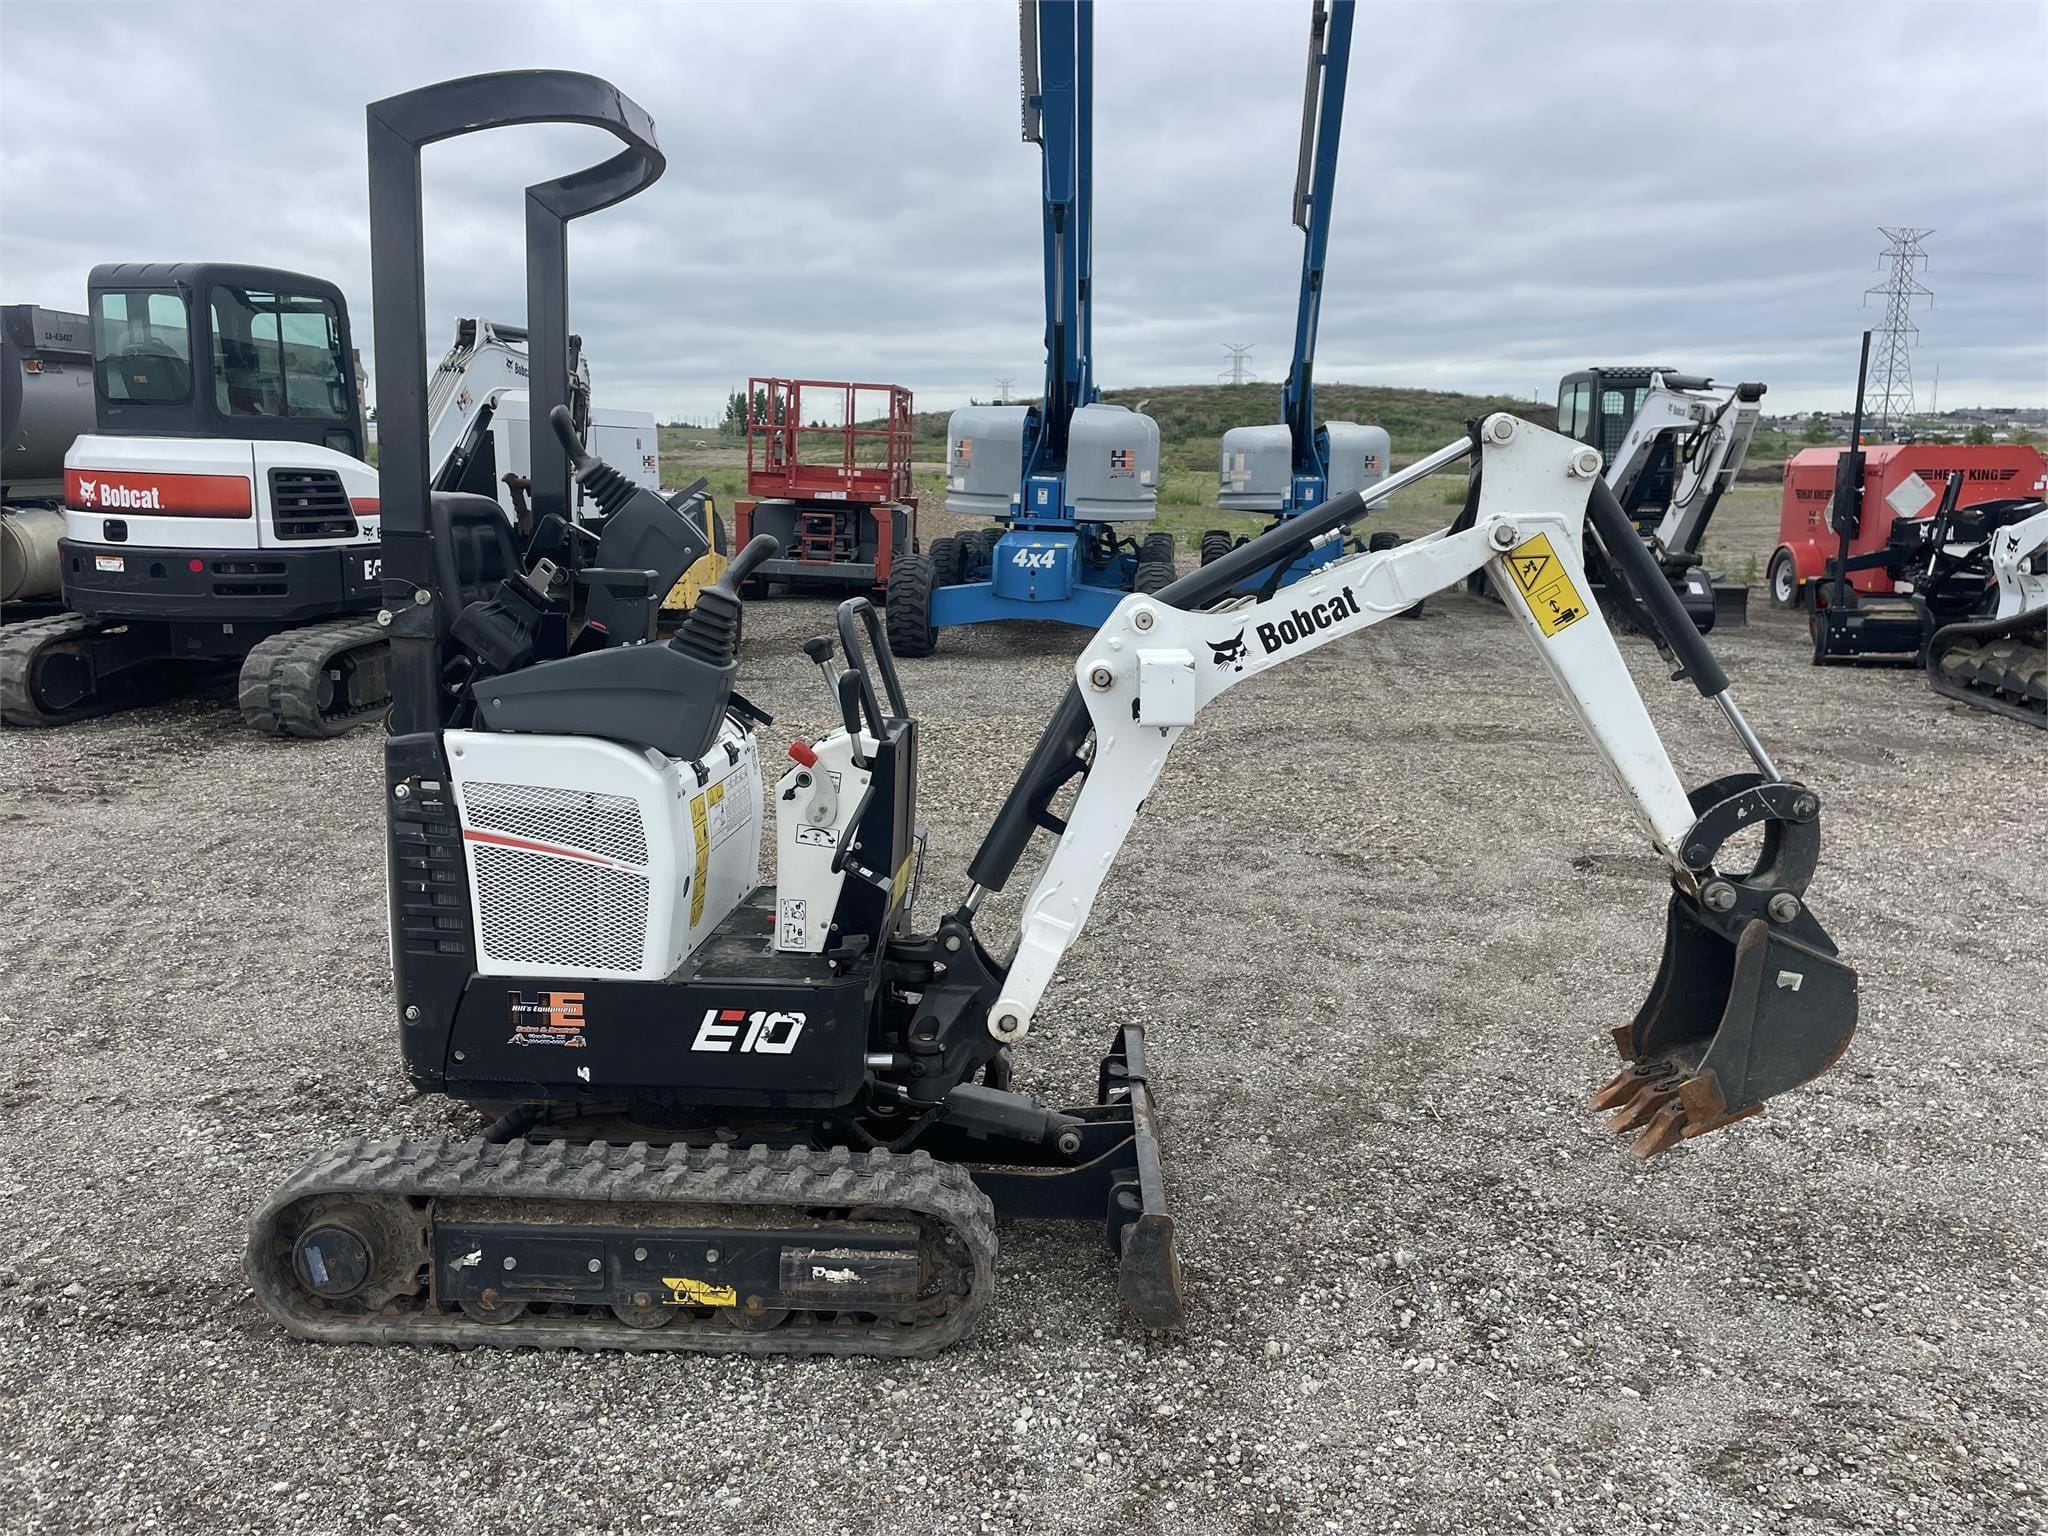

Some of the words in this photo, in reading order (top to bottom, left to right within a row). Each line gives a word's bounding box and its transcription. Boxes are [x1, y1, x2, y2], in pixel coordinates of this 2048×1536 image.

[1111, 449, 1136, 471] HE
[1933, 469, 1966, 481] HET
[1968, 469, 1999, 481] KING
[100, 483, 160, 509] Bobcat
[1012, 548, 1055, 568] 4x4
[1256, 586, 1361, 654] Bobcat
[507, 990, 586, 1027] HE
[690, 1009, 807, 1054] E10
